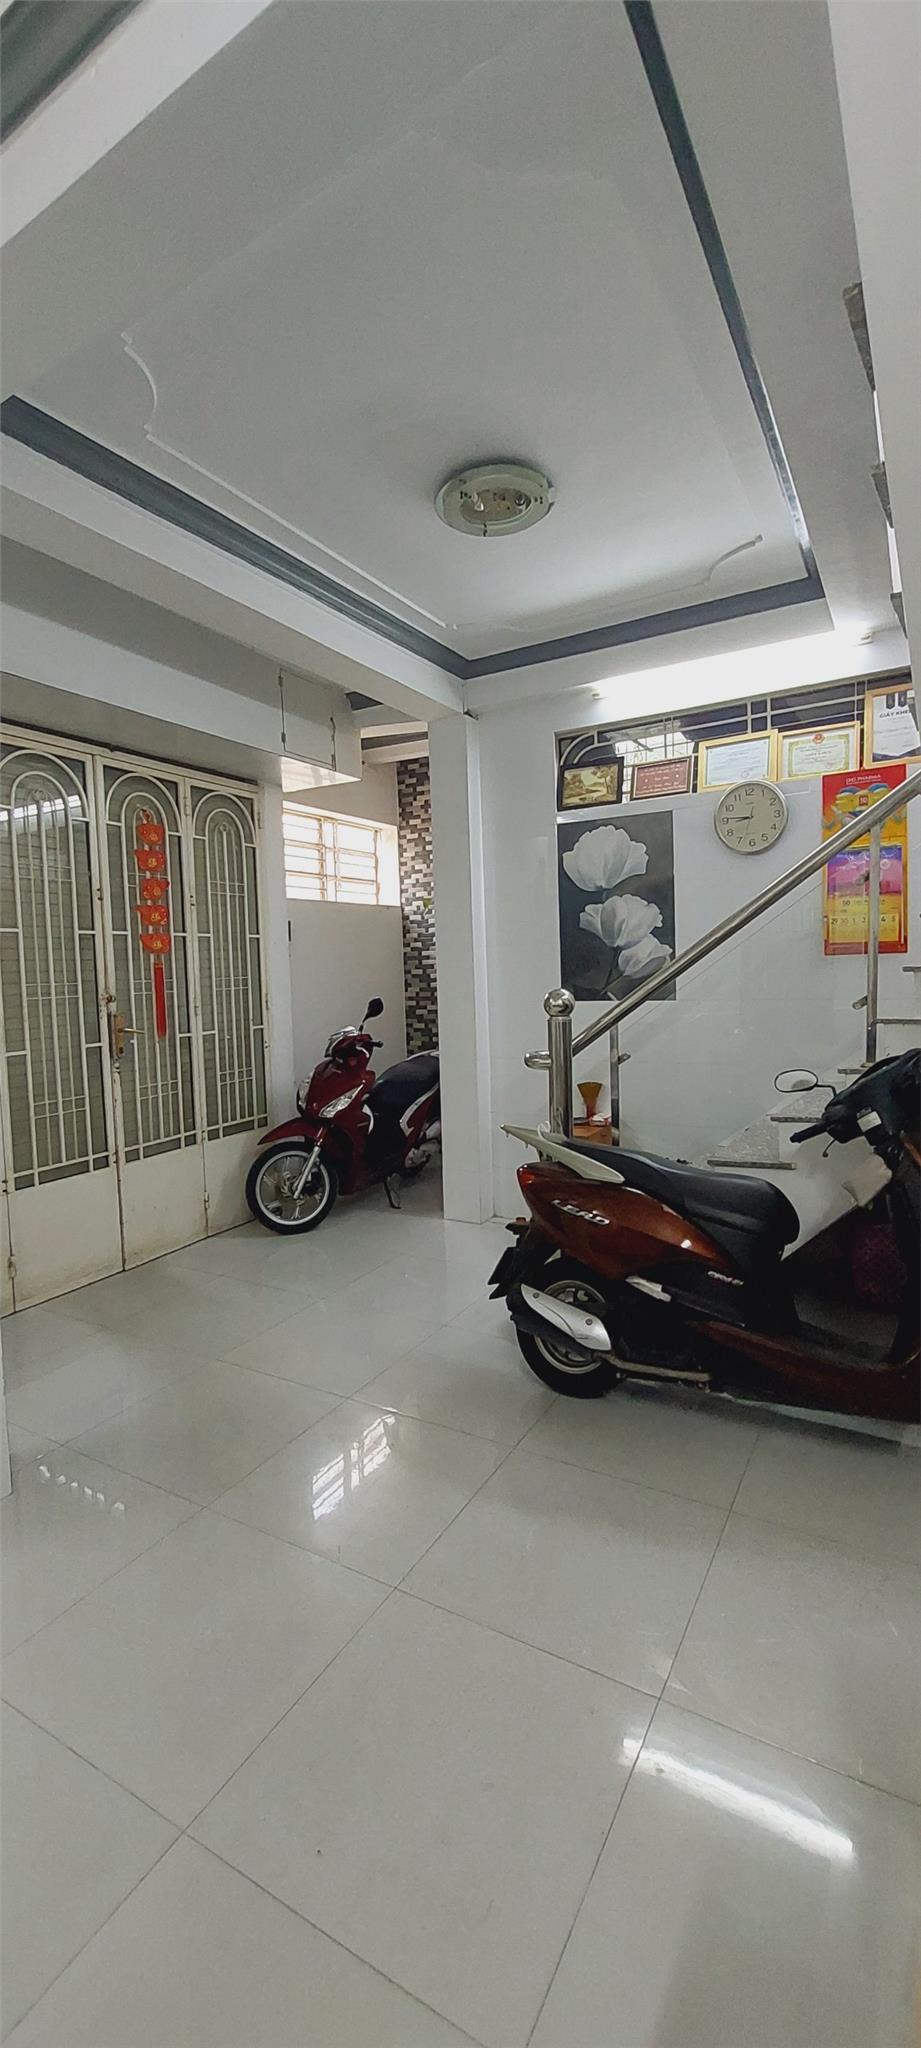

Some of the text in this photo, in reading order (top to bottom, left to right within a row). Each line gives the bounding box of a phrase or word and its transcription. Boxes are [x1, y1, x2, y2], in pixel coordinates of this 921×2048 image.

[745, 788, 754, 797] 12
[769, 798, 776, 806] 2
[725, 804, 734, 812] 10
[774, 810, 781, 818] 3
[722, 817, 729, 825] 9
[727, 829, 734, 837] 8
[761, 833, 768, 841] 5
[749, 839, 756, 847] 6
[551, 1199, 610, 1225] LEAD
